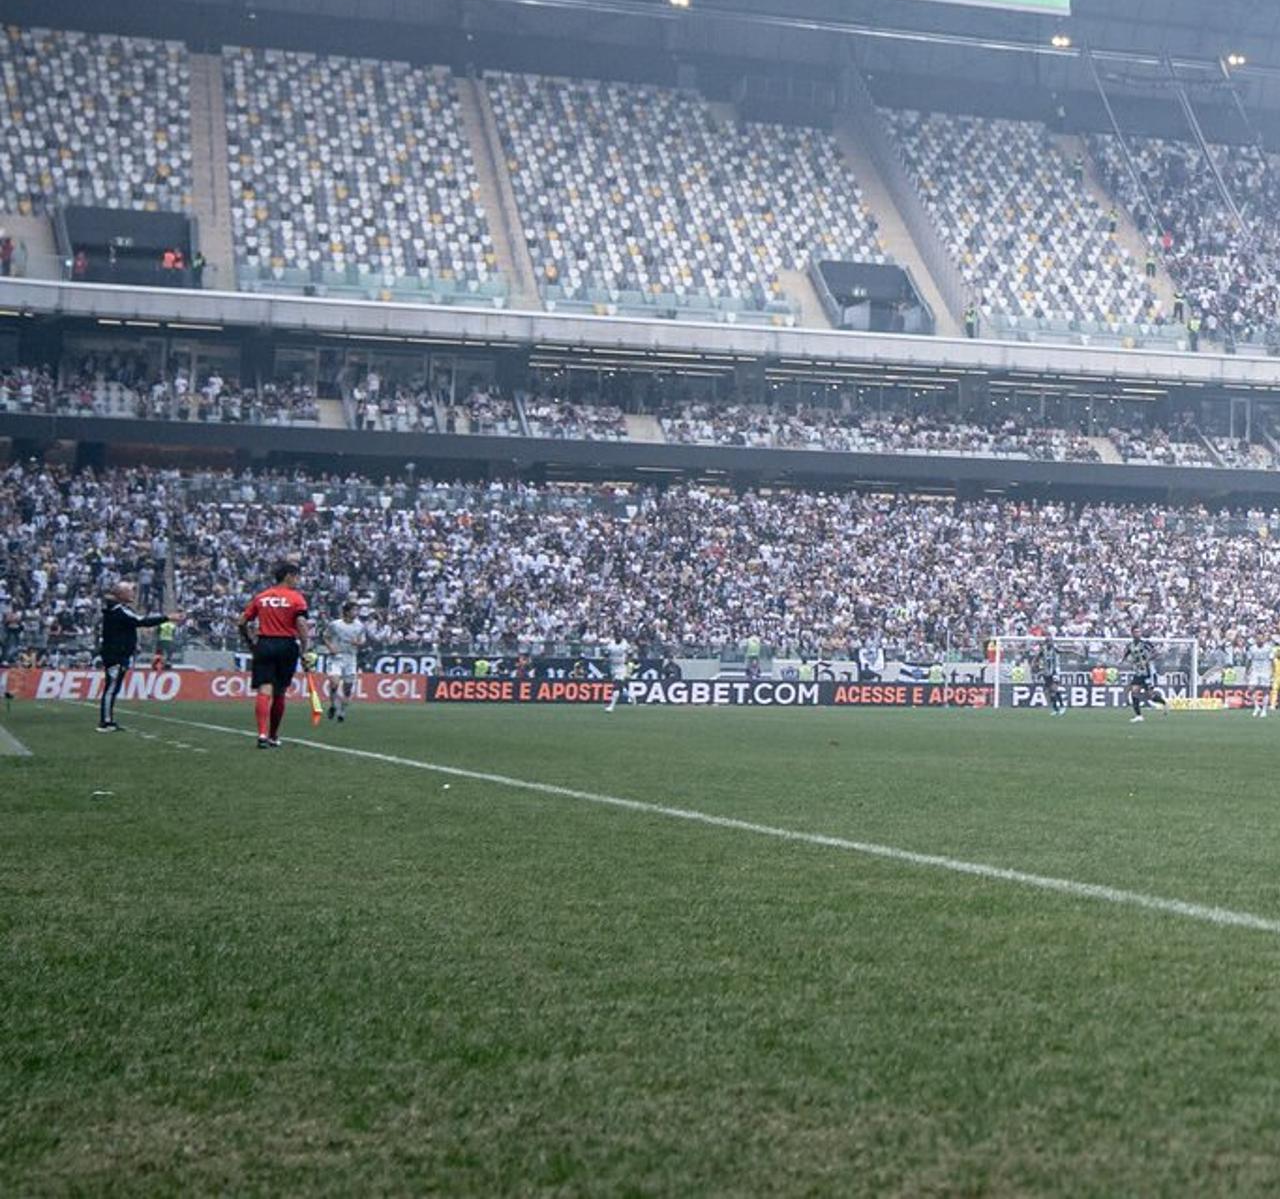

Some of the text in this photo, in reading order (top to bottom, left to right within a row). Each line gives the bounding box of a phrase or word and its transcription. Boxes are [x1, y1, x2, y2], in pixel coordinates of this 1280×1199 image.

[260, 597, 290, 607] TCL
[377, 677, 421, 698] GOL
[435, 680, 614, 700] ACESSE E APOSTE
[628, 681, 819, 704] PAGBET.COM
[835, 686, 907, 704] ACESSE
[913, 686, 923, 704] E
